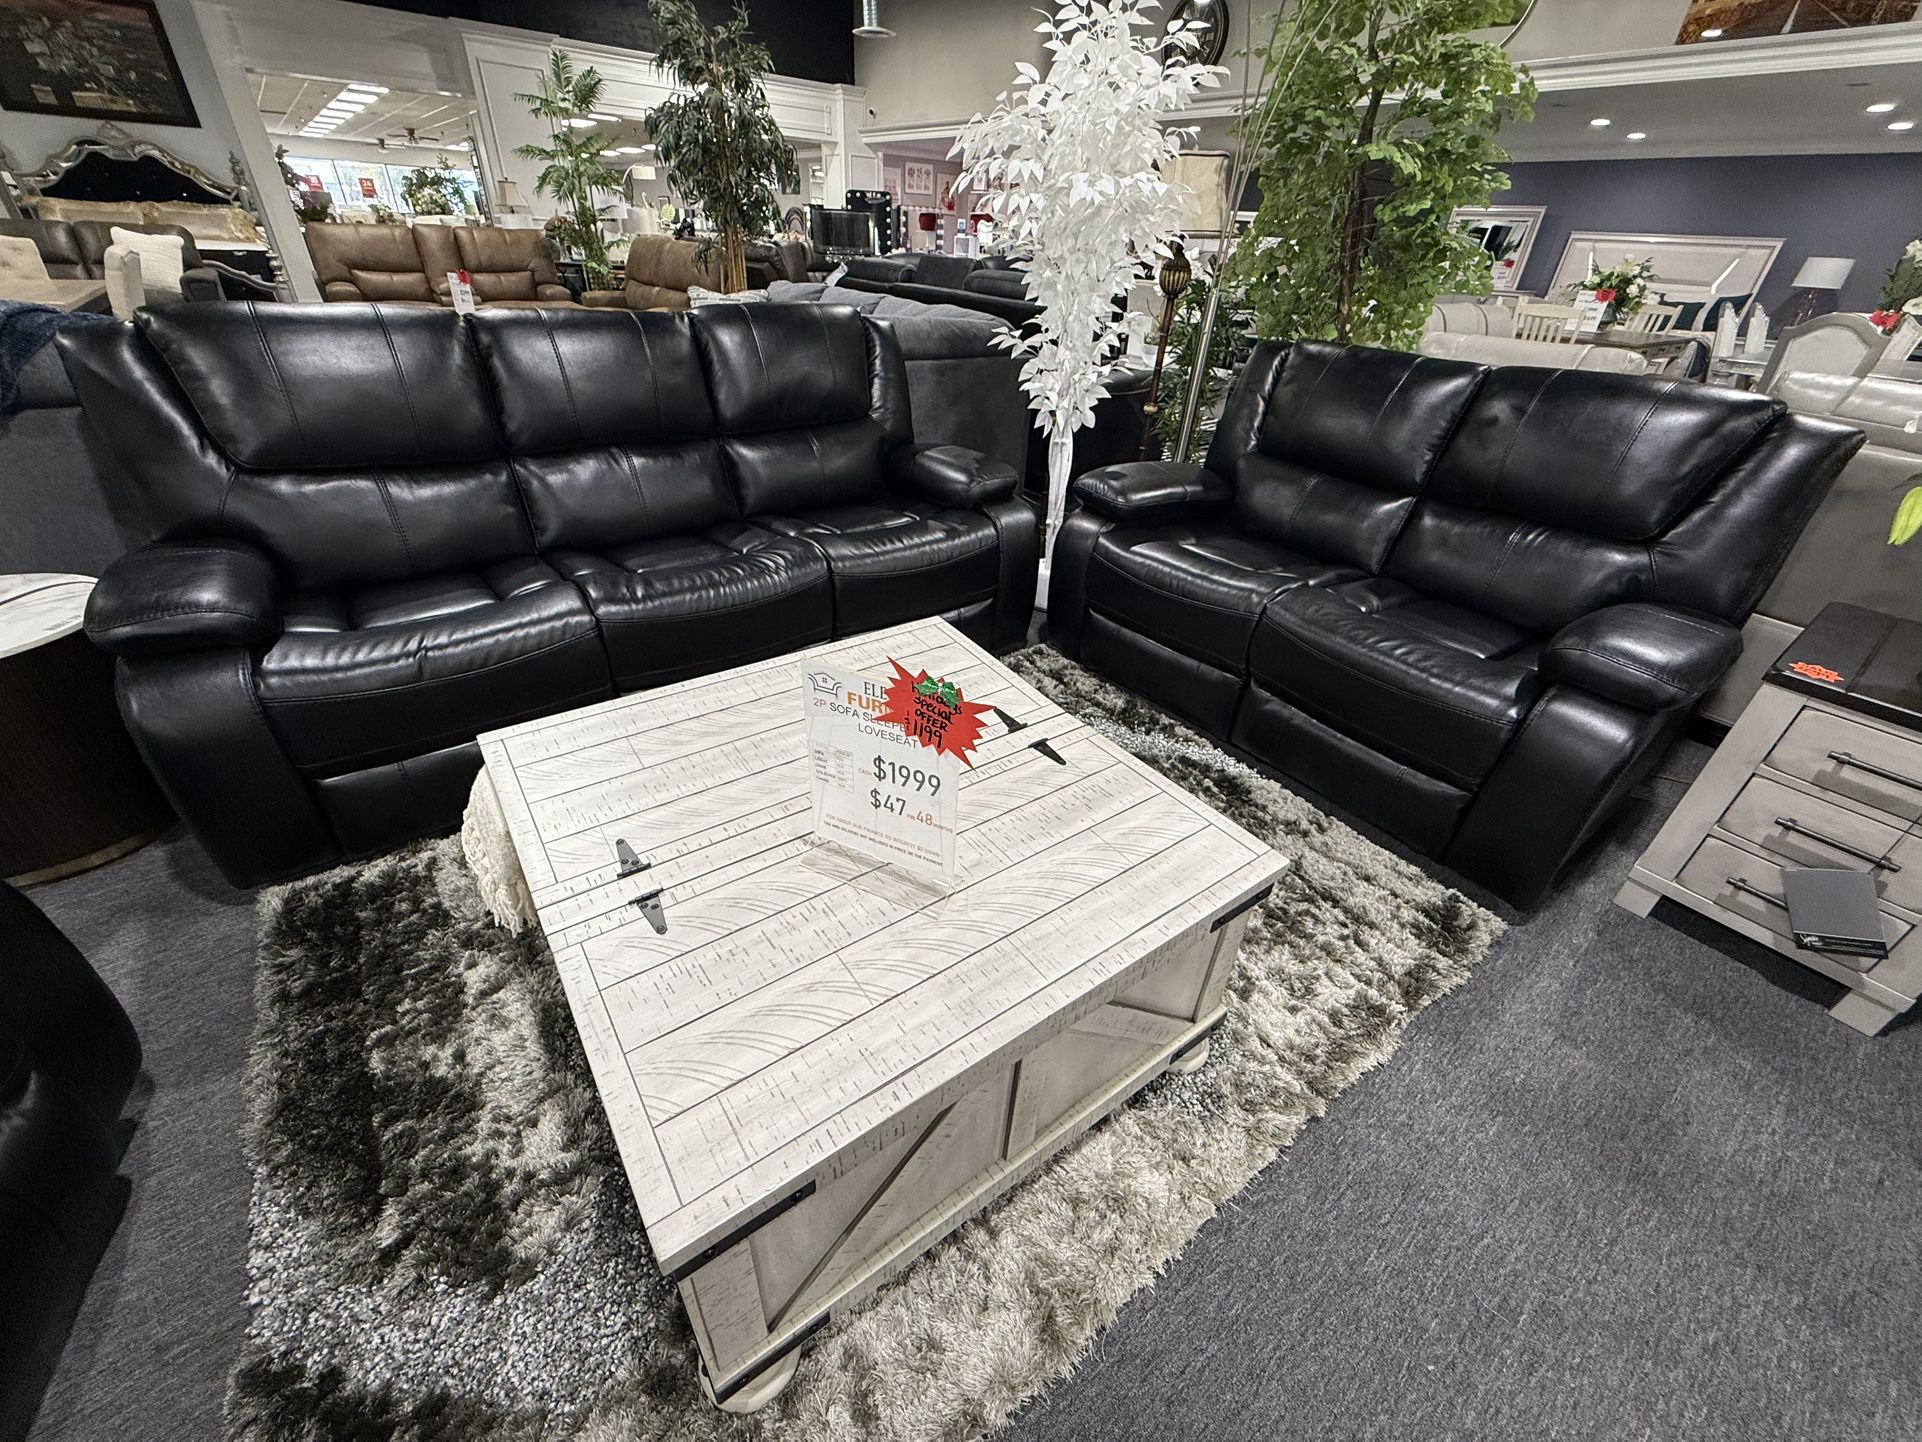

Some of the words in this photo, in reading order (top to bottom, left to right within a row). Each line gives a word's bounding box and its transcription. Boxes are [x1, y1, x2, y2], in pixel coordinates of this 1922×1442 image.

[813, 698, 826, 708] 2P
[830, 702, 859, 719] SOFA
[863, 712, 907, 733] SLEPE
[847, 691, 890, 714] FUR
[858, 722, 918, 749] LOVESEAT
[915, 708, 949, 733] OFFER
[873, 755, 941, 797] $1999
[870, 788, 907, 816] $47
[916, 811, 933, 826] 48
